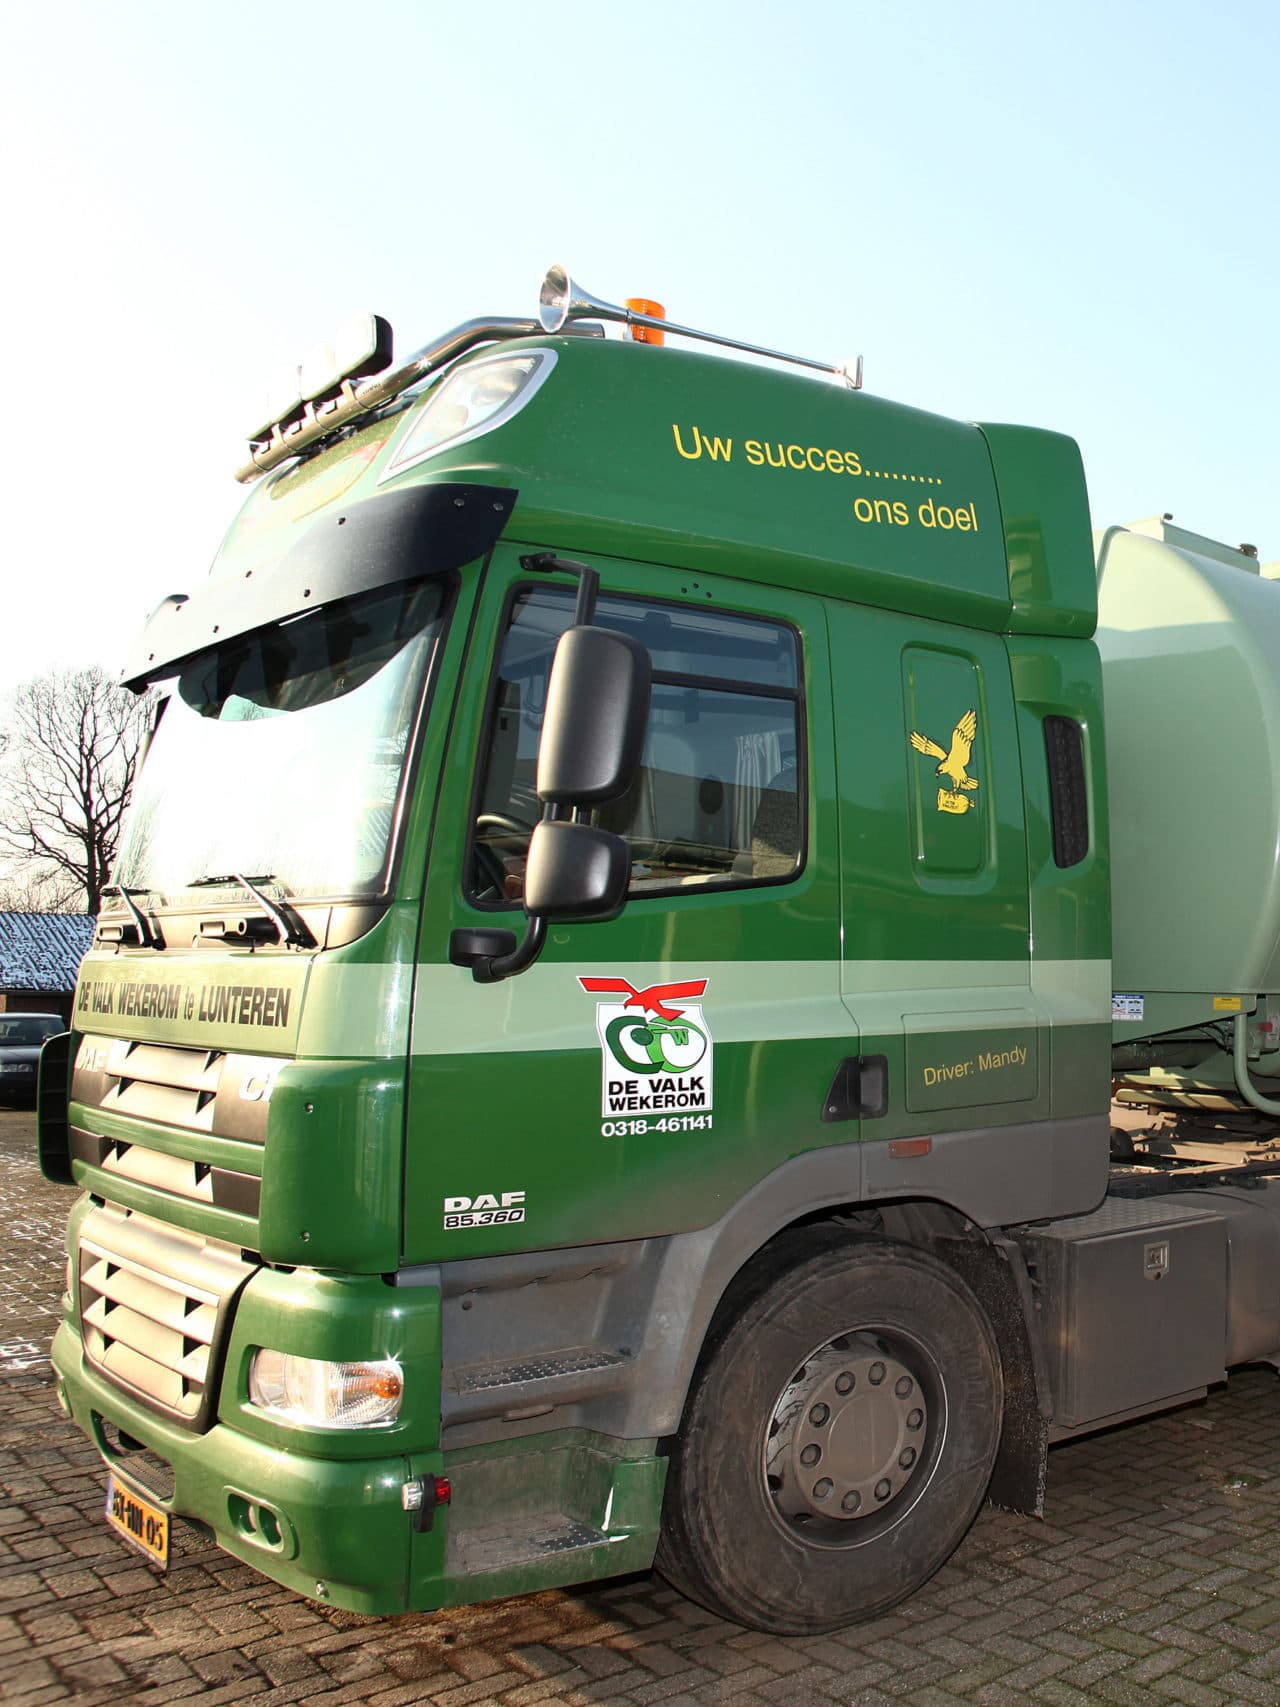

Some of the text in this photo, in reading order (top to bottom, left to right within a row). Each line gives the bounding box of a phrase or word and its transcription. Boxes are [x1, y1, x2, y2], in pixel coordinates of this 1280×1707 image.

[672, 424, 732, 462] Uw
[853, 497, 979, 532] ons doel
[78, 981, 292, 1028] DE VALK WEKEROM te LUNTEREN
[923, 1045, 1028, 1086] Driver: Mandy
[608, 1076, 704, 1096] DE VALK
[609, 1092, 706, 1112] WEKEROM
[601, 1115, 713, 1138] 0318-461141
[444, 1191, 526, 1213] DAF
[445, 1209, 524, 1228] 85.360
